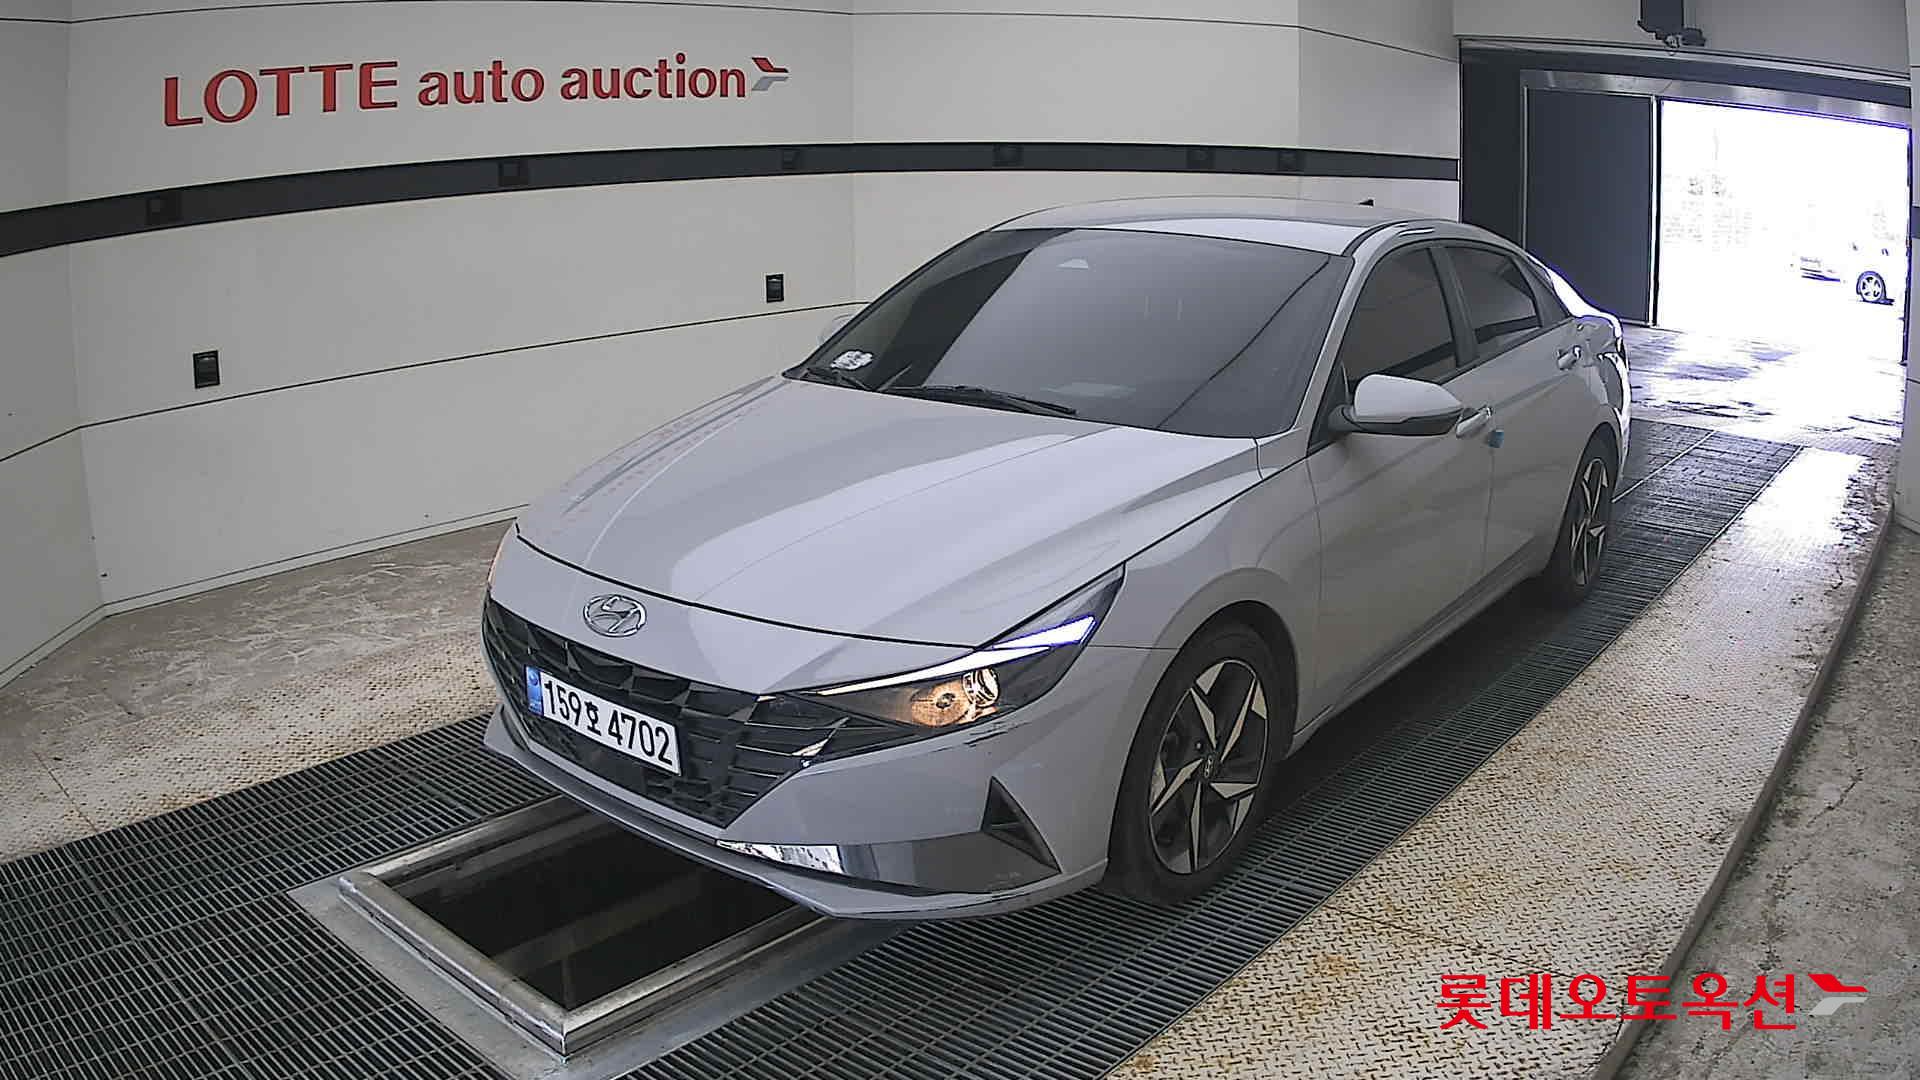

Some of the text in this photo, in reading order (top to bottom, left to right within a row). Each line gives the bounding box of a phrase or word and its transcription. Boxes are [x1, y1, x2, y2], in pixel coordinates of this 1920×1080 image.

[164, 53, 747, 127] LOTTE auto auction
[608, 709, 673, 766] 4702
